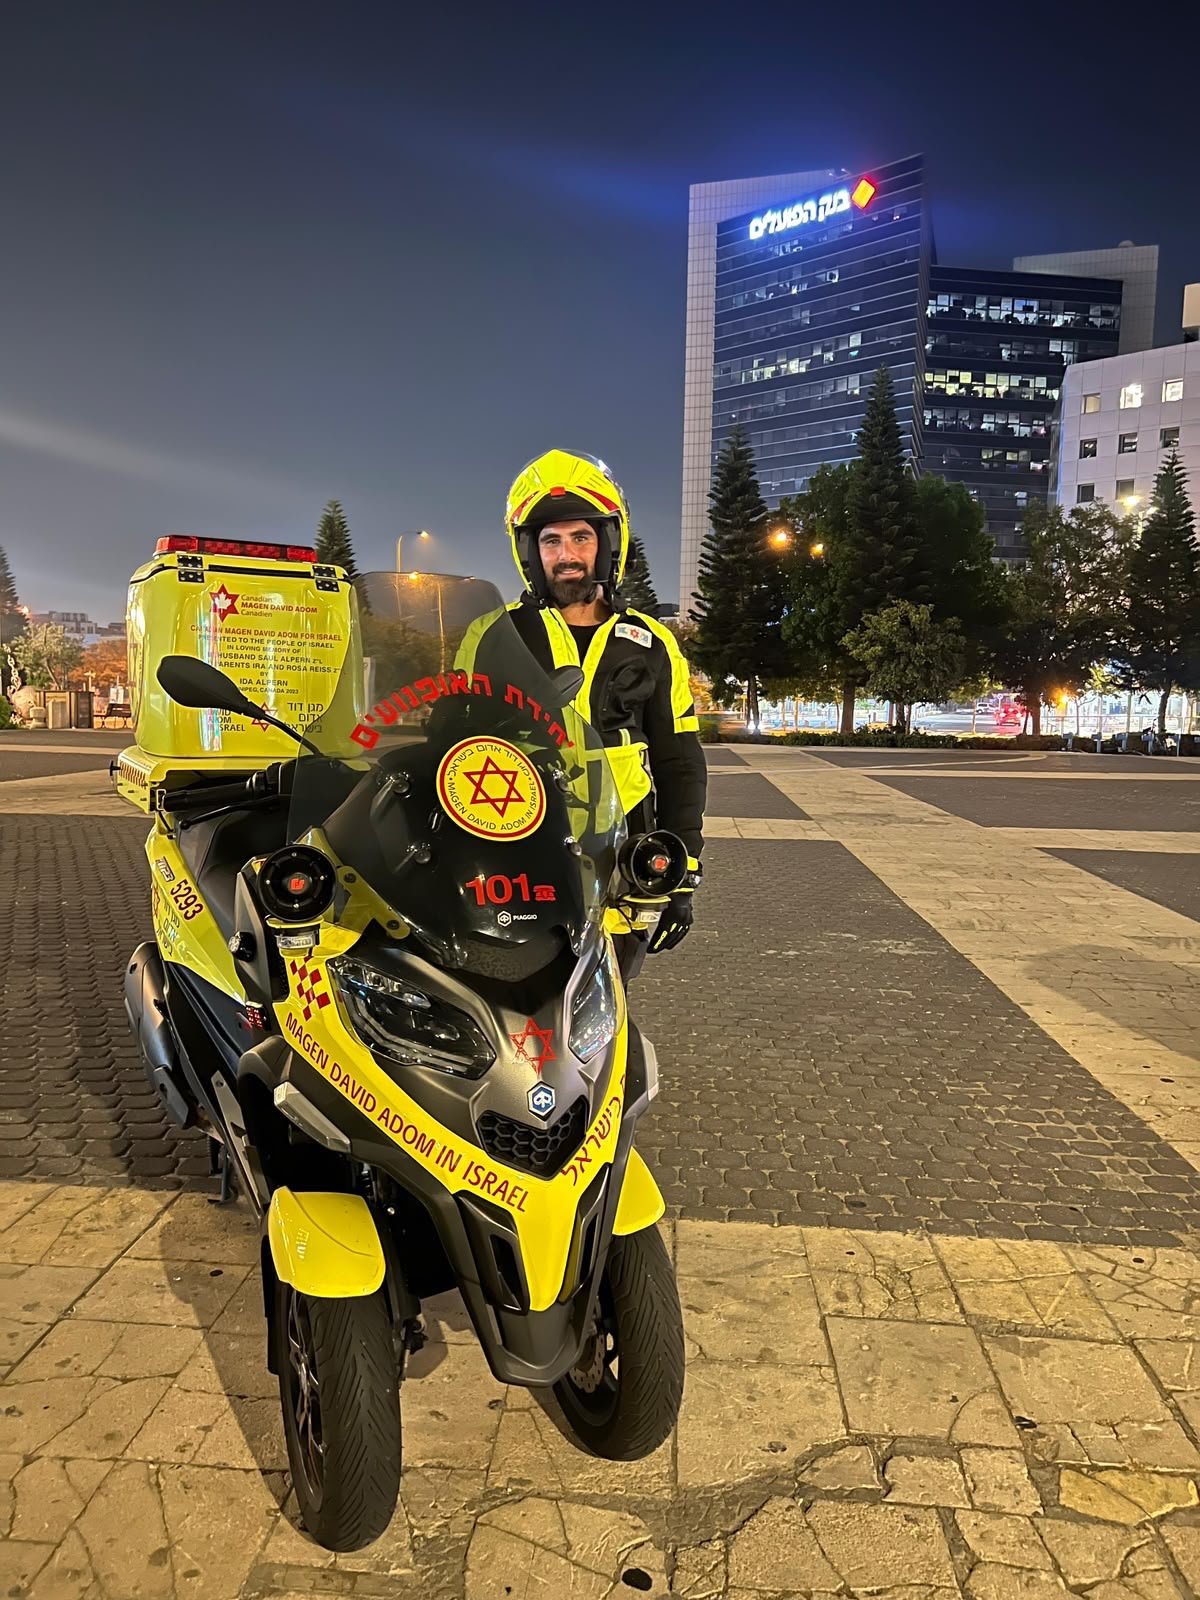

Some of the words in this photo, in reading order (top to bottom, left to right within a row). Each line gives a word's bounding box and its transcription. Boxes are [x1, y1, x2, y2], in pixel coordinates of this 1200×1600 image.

[818, 188, 850, 222] בנק
[750, 200, 816, 240] הפועלים
[241, 594, 272, 602] Canadian
[241, 609, 272, 617] Canadien
[270, 604, 293, 612] DAVID
[190, 625, 222, 634] CANADN
[225, 628, 252, 636] MAGEN
[254, 629, 275, 637] DAVID
[316, 633, 342, 641] ISRAEL
[218, 652, 255, 660] HUSBAND
[258, 654, 278, 662] SAUL
[287, 702, 303, 711] דוד
[308, 703, 323, 713] מגן
[350, 672, 492, 750] האופנועים
[504, 683, 574, 748] יחידת
[476, 744, 501, 753] אדום
[504, 749, 518, 762] דוד
[447, 748, 475, 777] בישראל
[517, 762, 530, 777] מגן
[448, 782, 467, 814] MAGEN
[467, 813, 496, 829] DAVID
[500, 817, 526, 830] ADOM
[525, 809, 533, 819] IN
[529, 781, 537, 811] ISRAEL
[466, 873, 530, 905] 101
[171, 879, 203, 920] 5293
[286, 1012, 329, 1070] MAGEN
[330, 1062, 376, 1112] DAVID
[377, 1107, 436, 1157] ADOM
[435, 1145, 462, 1172] IN
[462, 1161, 529, 1212] ISRAEL
